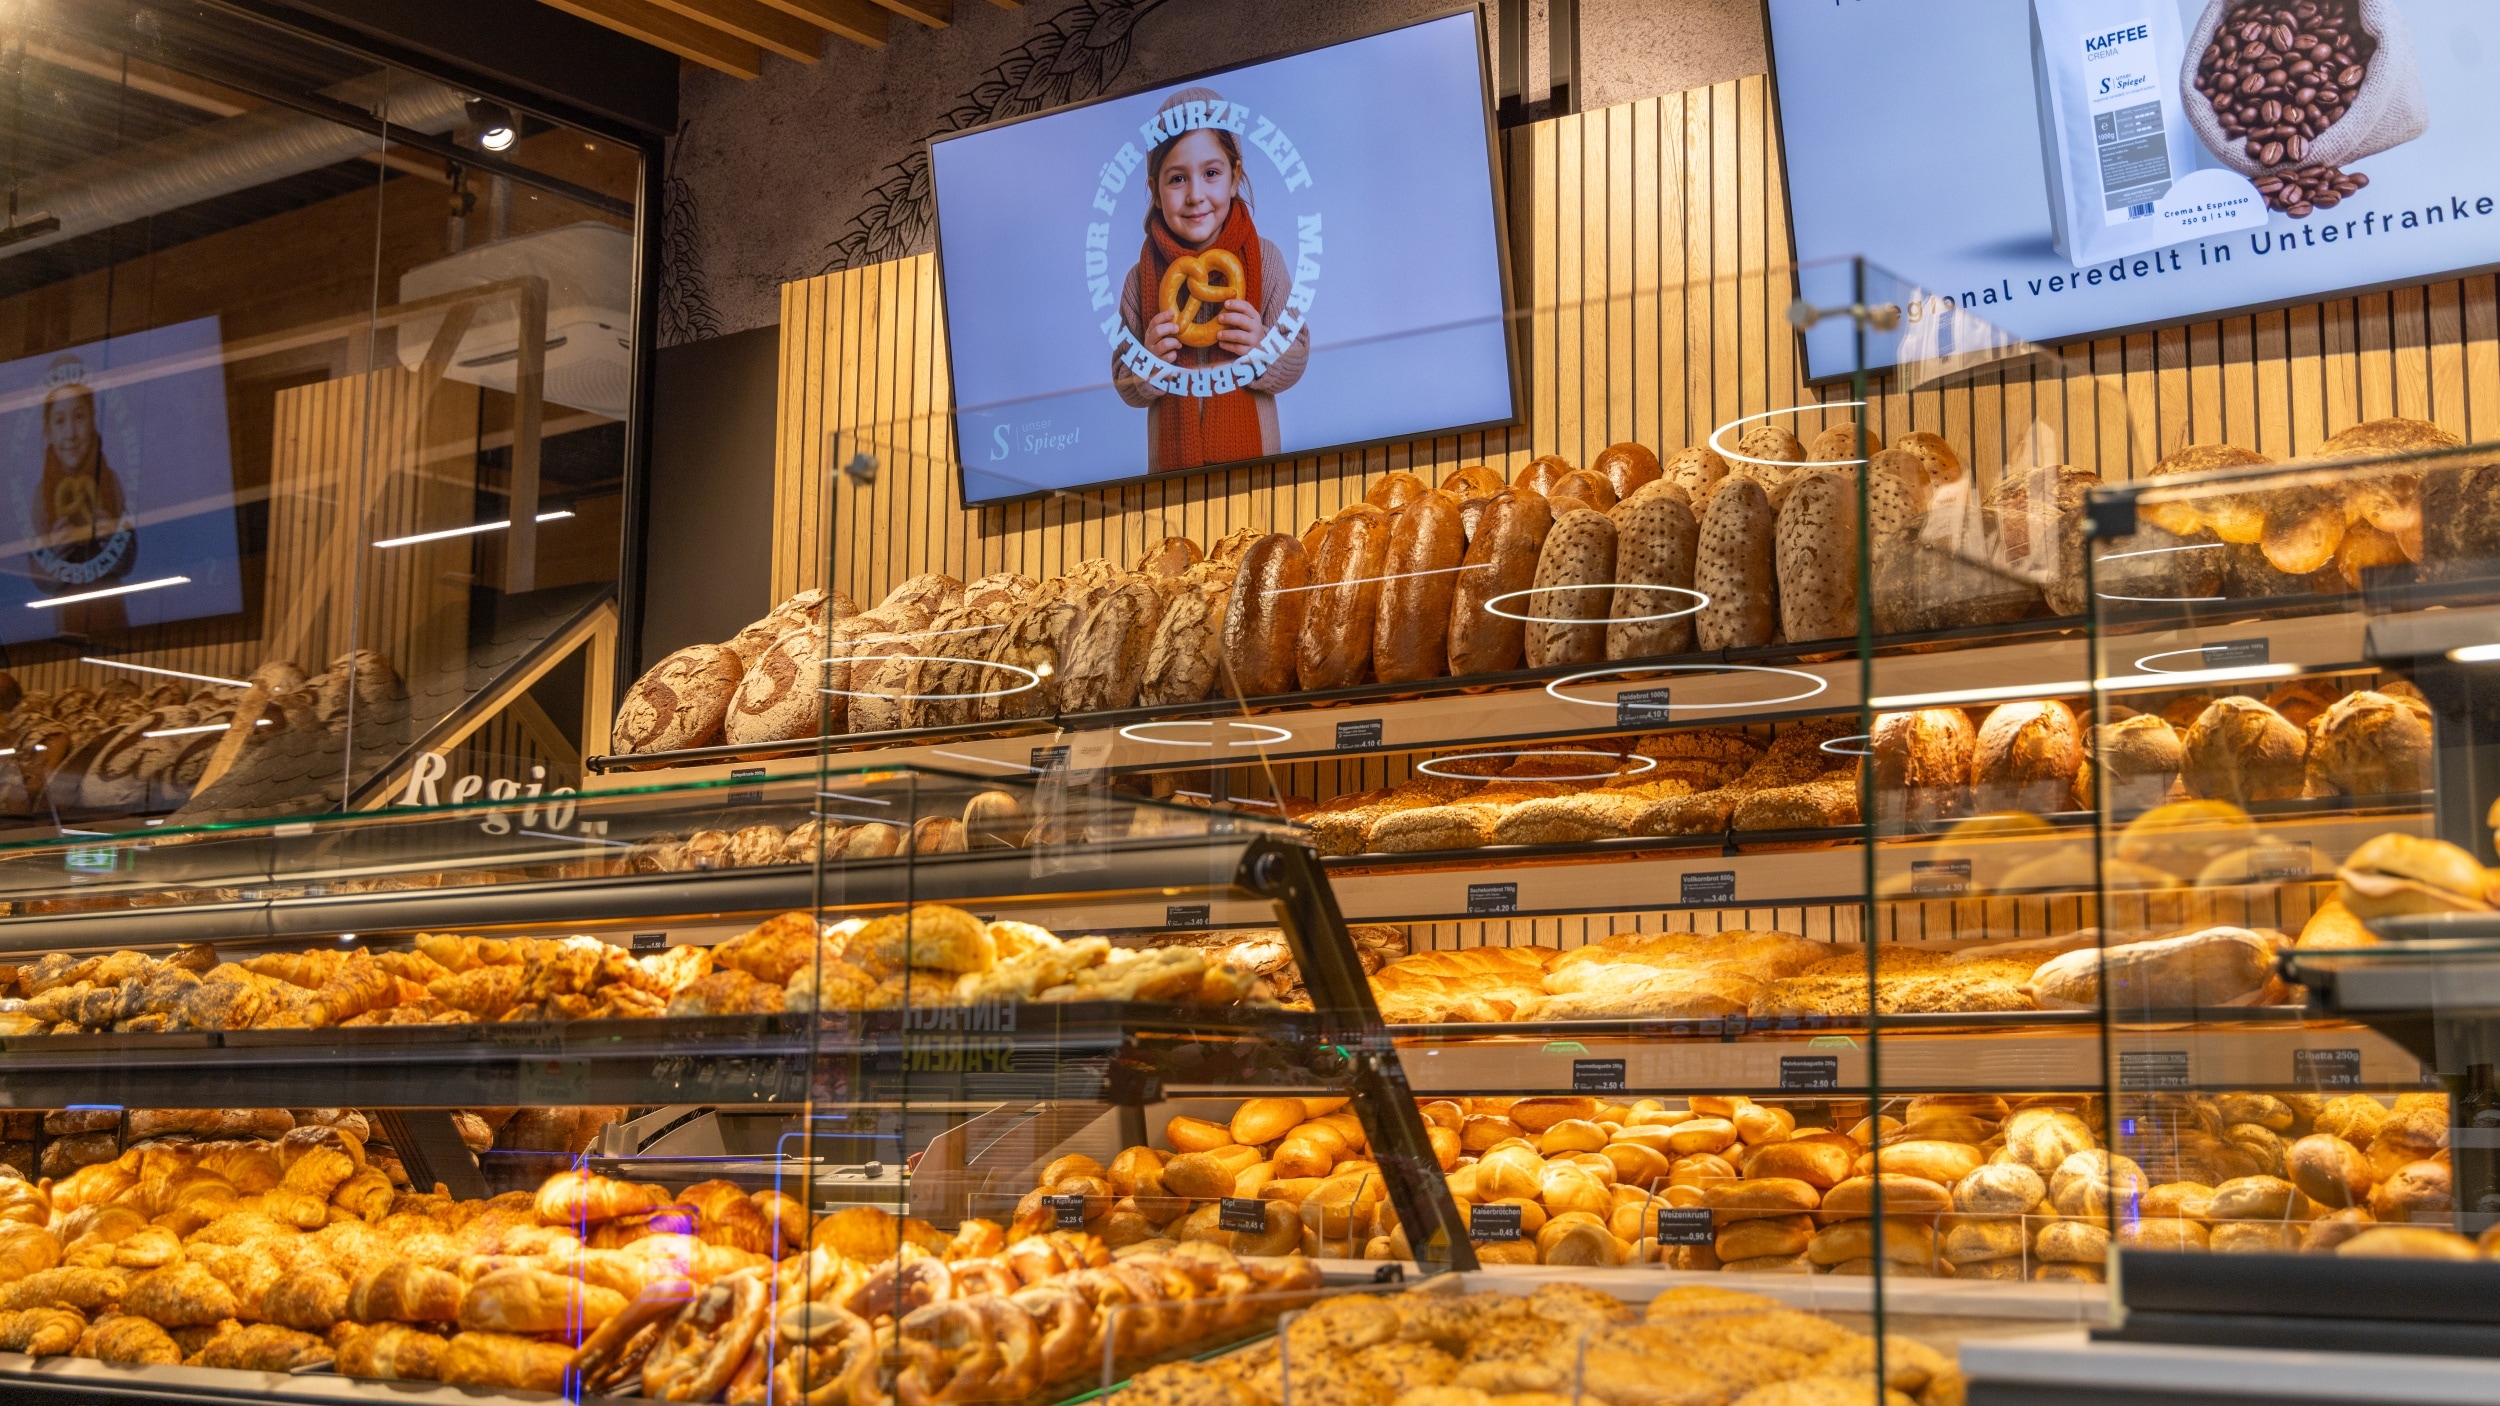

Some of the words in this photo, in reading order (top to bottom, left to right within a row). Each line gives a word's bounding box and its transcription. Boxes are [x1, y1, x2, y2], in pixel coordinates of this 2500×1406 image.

[2086, 24, 2148, 52] KAFFEE
[2087, 48, 2119, 62] CREMA
[2117, 75, 2146, 90] Spiegel
[1139, 100, 1250, 152] KURZE
[1248, 114, 1313, 194] ZEIT
[1092, 141, 1144, 216] FÜR
[2164, 206, 2193, 218] Crema
[2197, 204, 2203, 212] &
[2207, 196, 2249, 212] Espresso
[2182, 216, 2199, 225] 250
[2225, 209, 2236, 217] kg
[1086, 222, 1115, 312] NUR
[1889, 279, 2012, 324] egional
[2028, 248, 2182, 296] veredelt
[2200, 243, 2232, 266] in
[2251, 196, 2494, 256] Unterfranke
[1100, 212, 1323, 397] MARTINSBREZELN
[1022, 419, 1052, 432] unser
[1024, 427, 1080, 454] Spiegel
[396, 752, 607, 835] Regio
[2335, 1051, 2358, 1061] 250g
[2354, 1075, 2359, 1084] €
[1222, 1199, 1235, 1208] Kipf
[1660, 1210, 1709, 1218] Weizenkrusti
[1499, 1229, 1513, 1237] 0,45
[1689, 1232, 1704, 1241] 0,90
[1707, 1232, 1712, 1240] €
